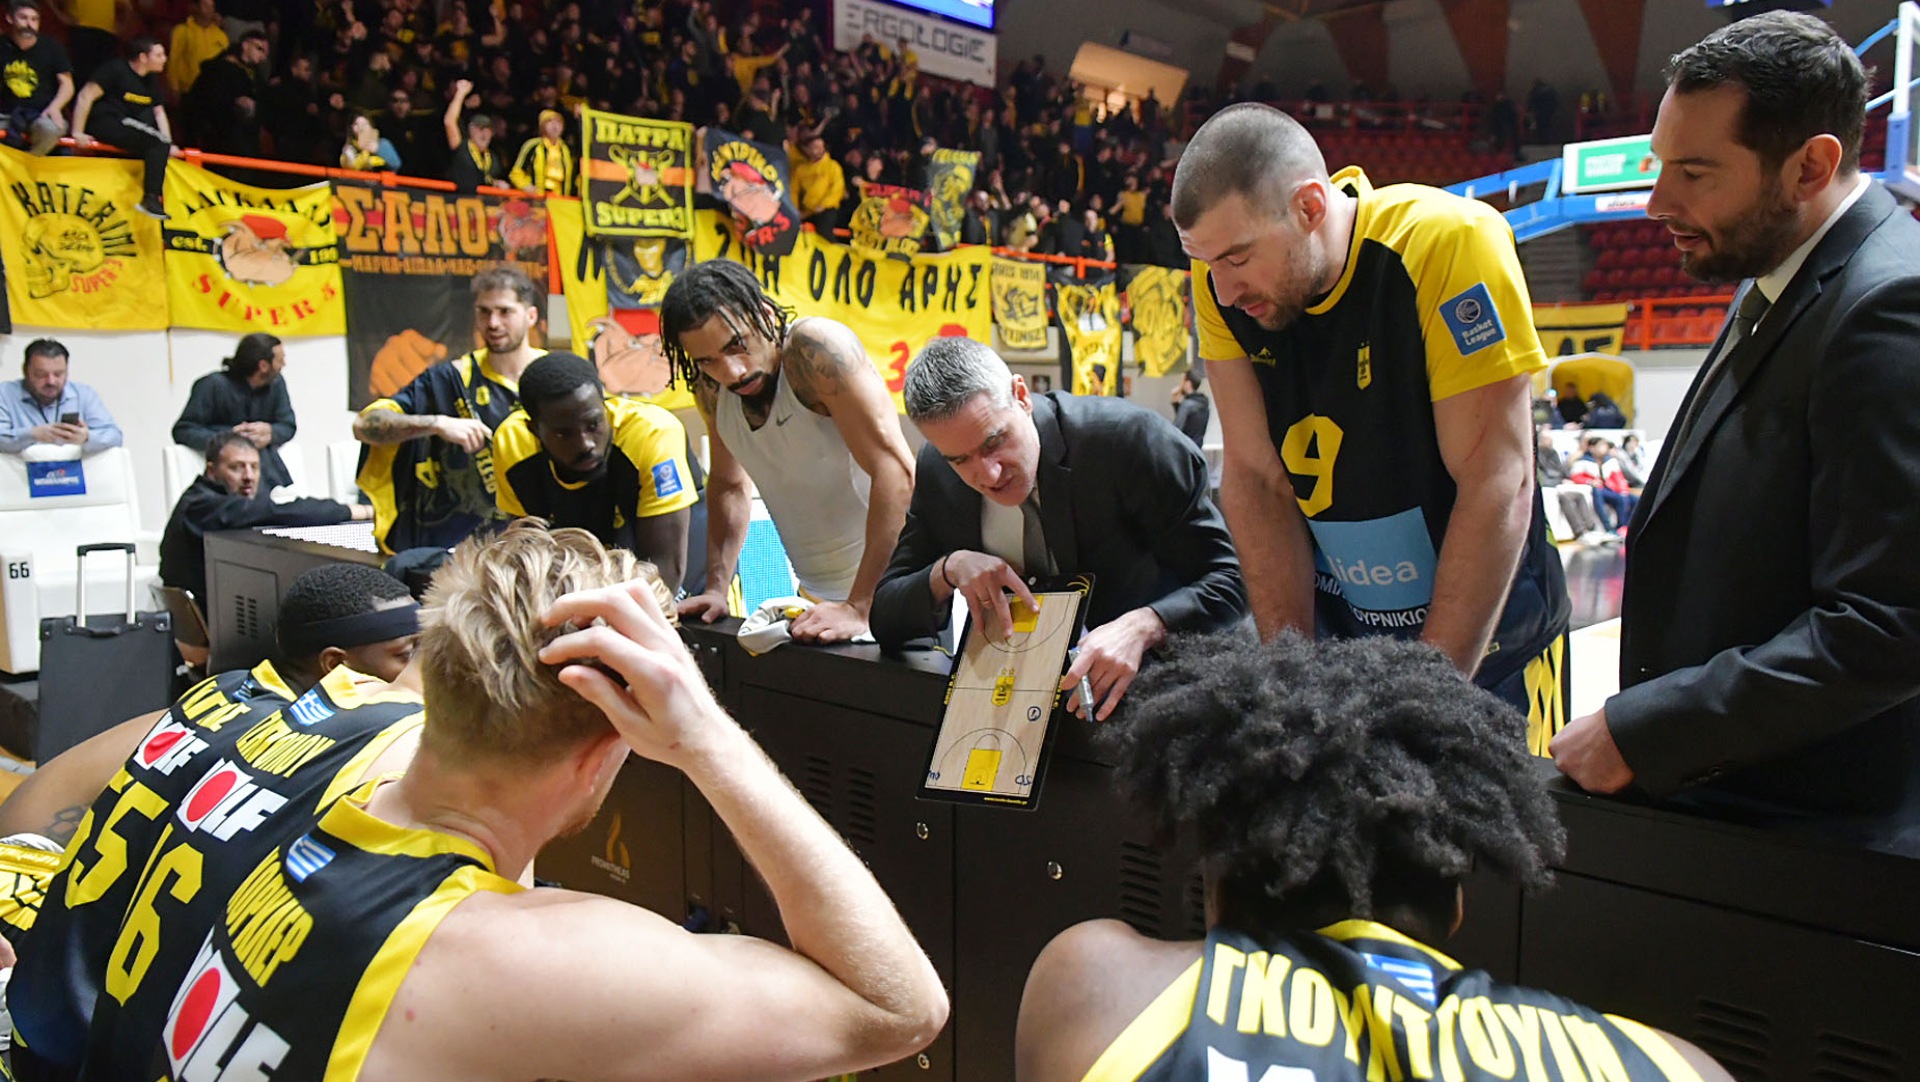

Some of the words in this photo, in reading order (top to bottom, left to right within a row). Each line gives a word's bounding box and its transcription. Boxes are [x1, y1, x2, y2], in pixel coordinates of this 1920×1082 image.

[846, 4, 985, 63] ERGOLOGIE
[596, 119, 685, 151] ΠΑΤΡΑ
[809, 247, 877, 309] ΟΛΟ
[900, 263, 983, 314] ΑΡΗΣ
[1281, 412, 1344, 519] 9
[8, 561, 31, 579] 66
